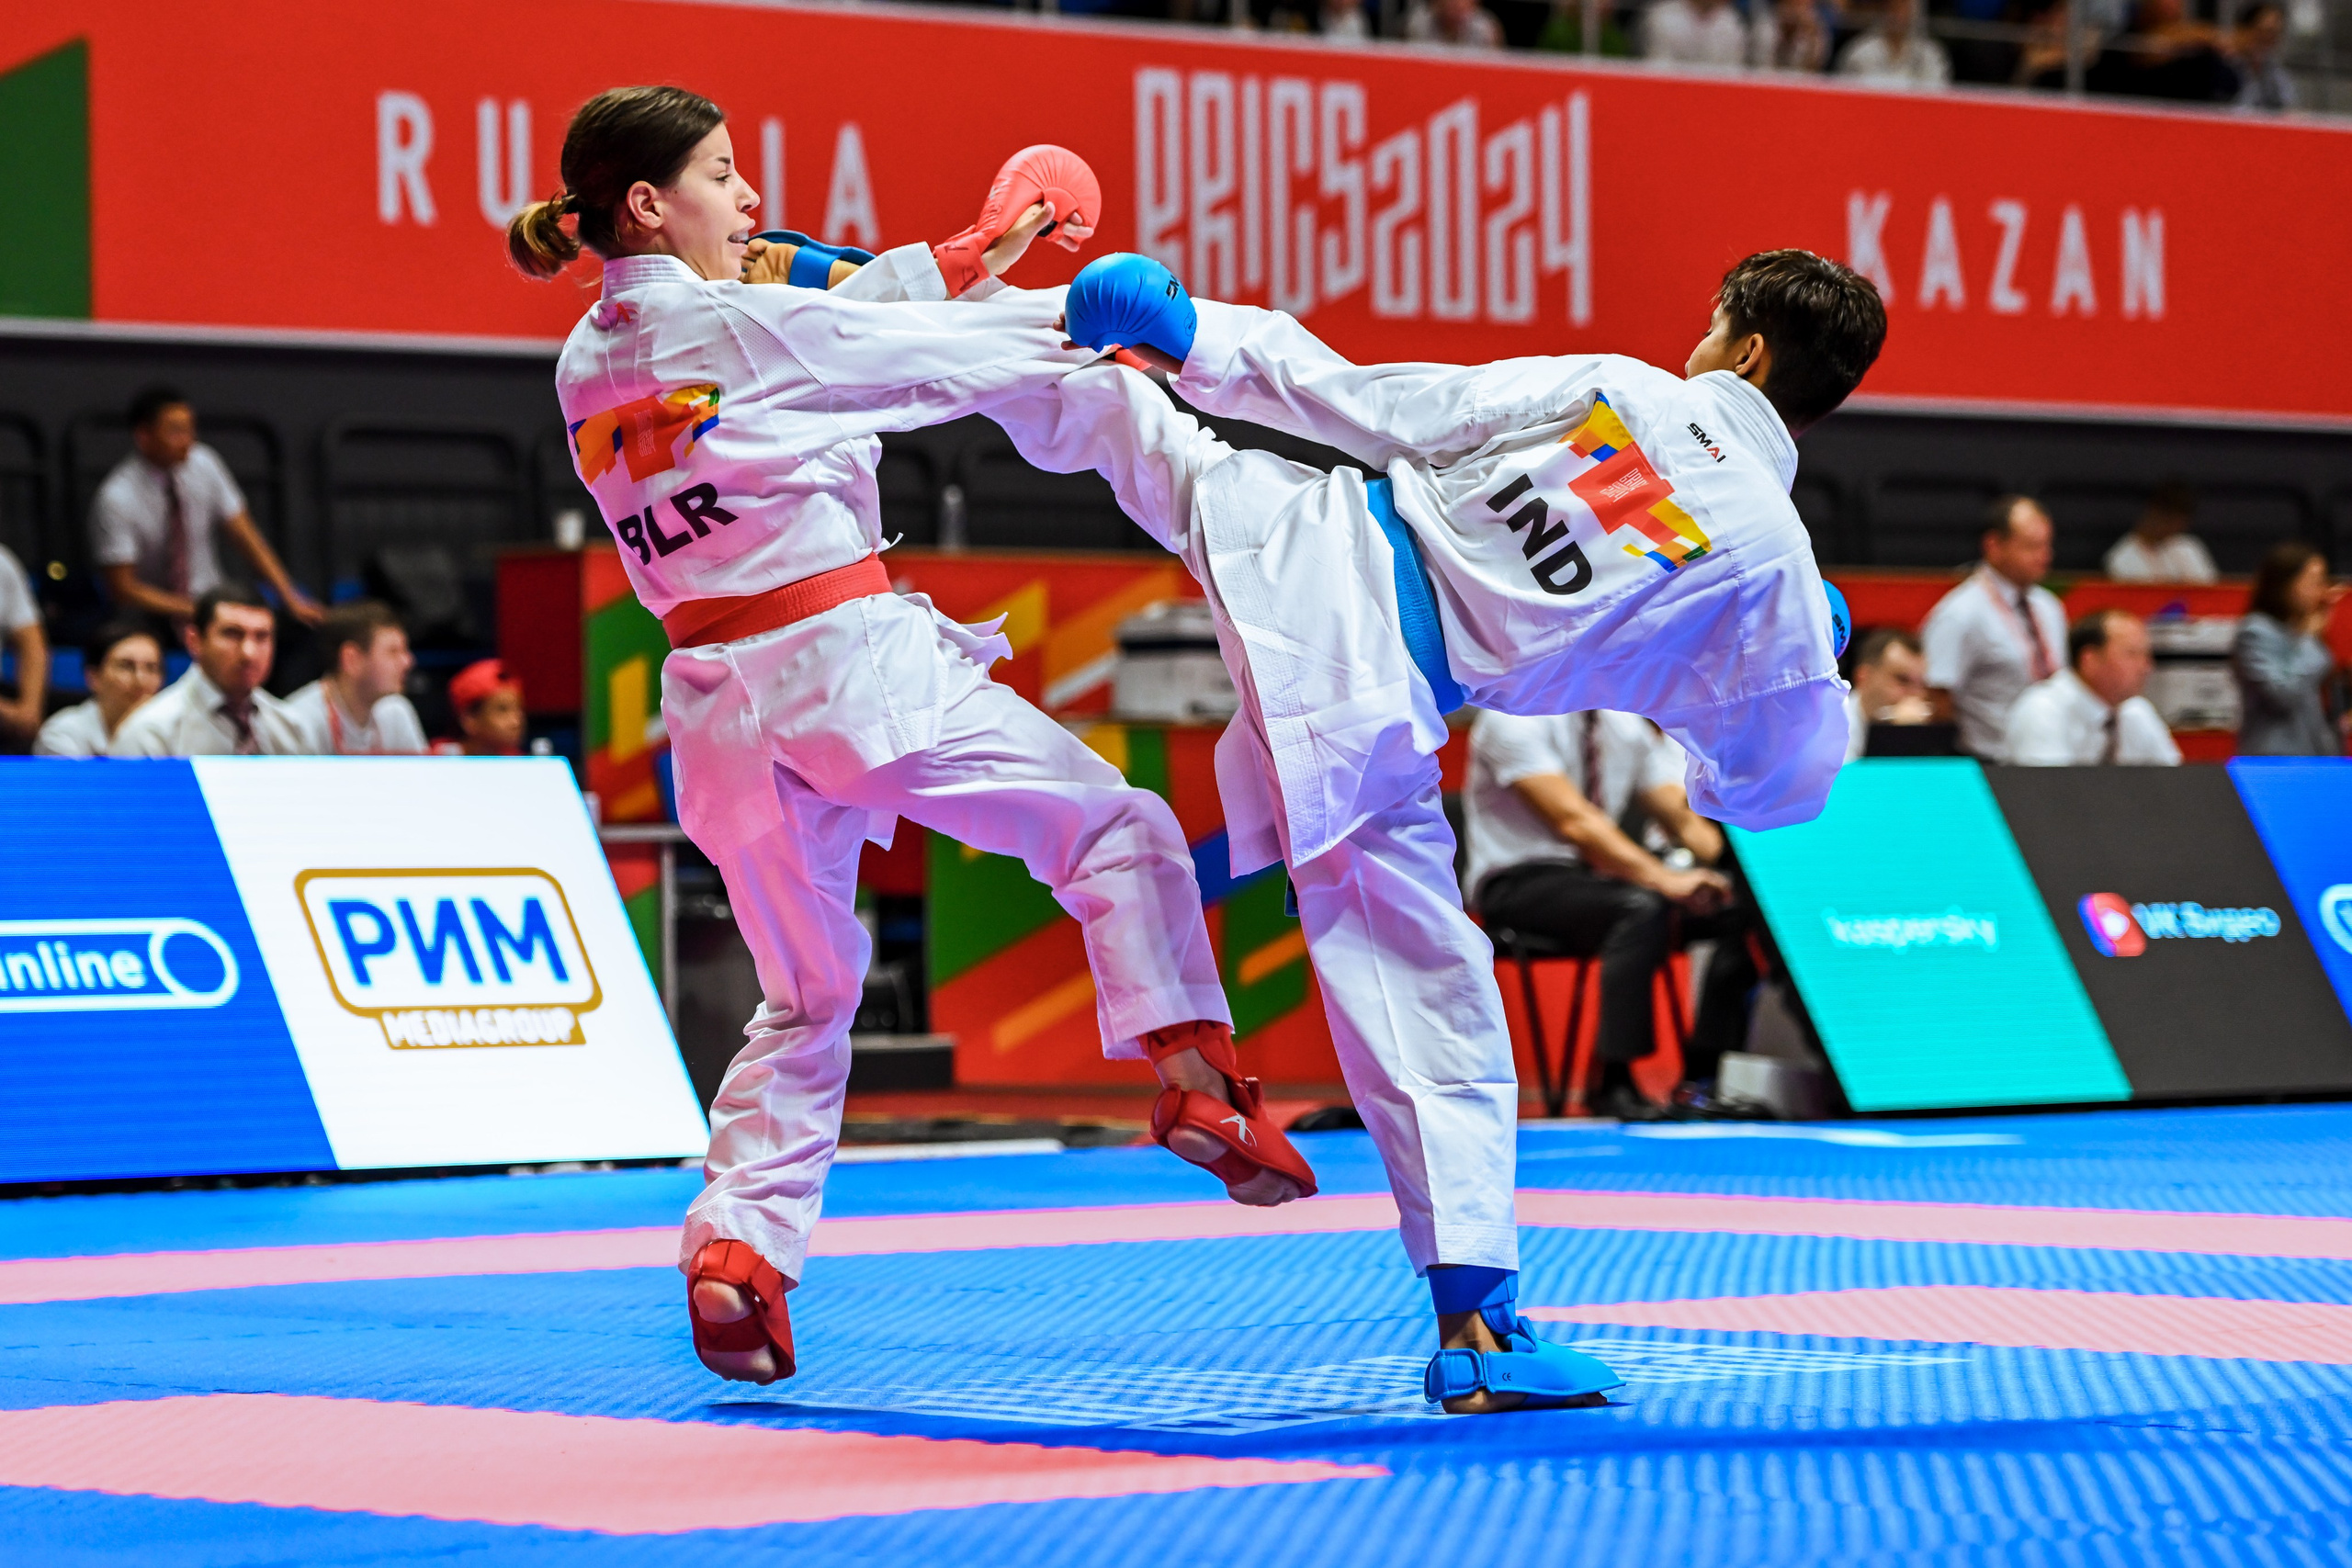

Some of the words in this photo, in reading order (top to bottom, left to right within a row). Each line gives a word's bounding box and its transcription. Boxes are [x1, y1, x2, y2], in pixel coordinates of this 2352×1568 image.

[377, 90, 879, 249] RUIA
[1846, 189, 2166, 321] KAZAN
[1687, 423, 1726, 463] SMAI
[616, 482, 739, 566] BLR
[1486, 473, 1593, 595] IND
[326, 897, 571, 987] РИМ
